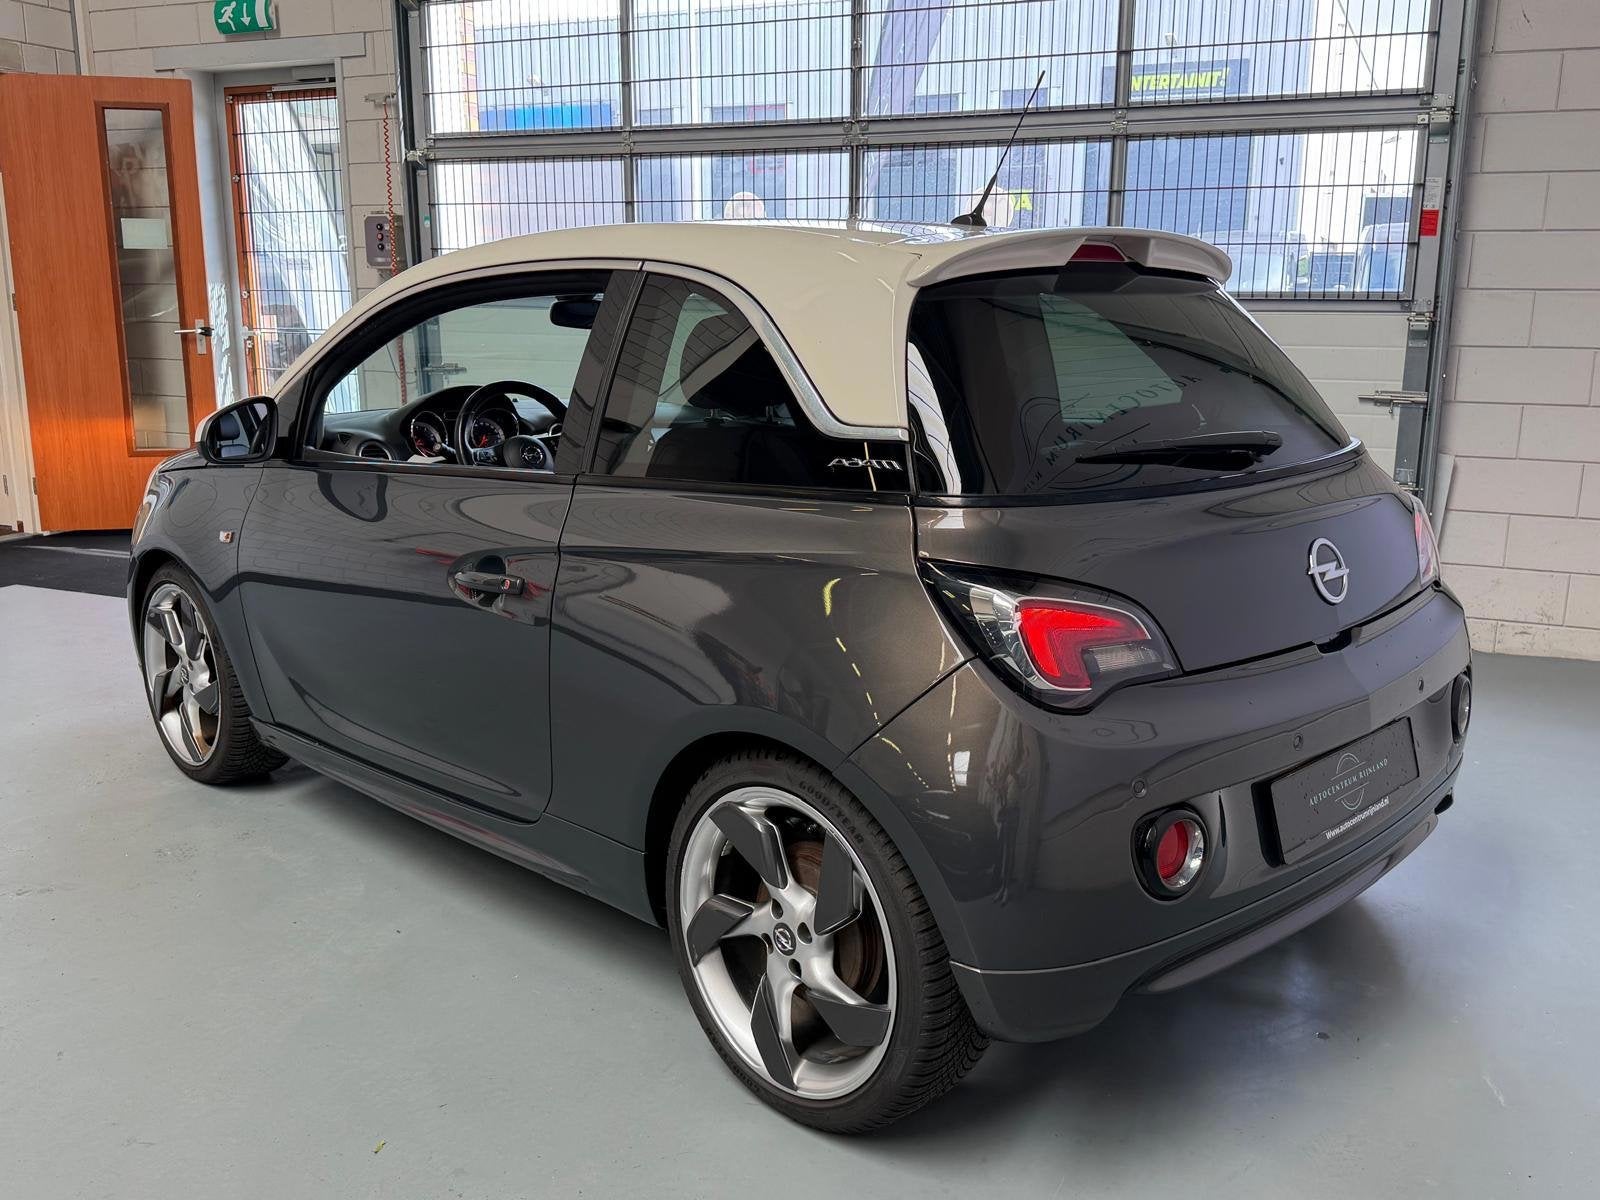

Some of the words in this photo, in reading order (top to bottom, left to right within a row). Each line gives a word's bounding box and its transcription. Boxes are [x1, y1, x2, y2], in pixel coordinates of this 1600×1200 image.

[1131, 67, 1230, 92] NTERTAINIT!
[1309, 773, 1358, 807] AUTOCENTRUM
[1359, 758, 1389, 780] RIJNLAND
